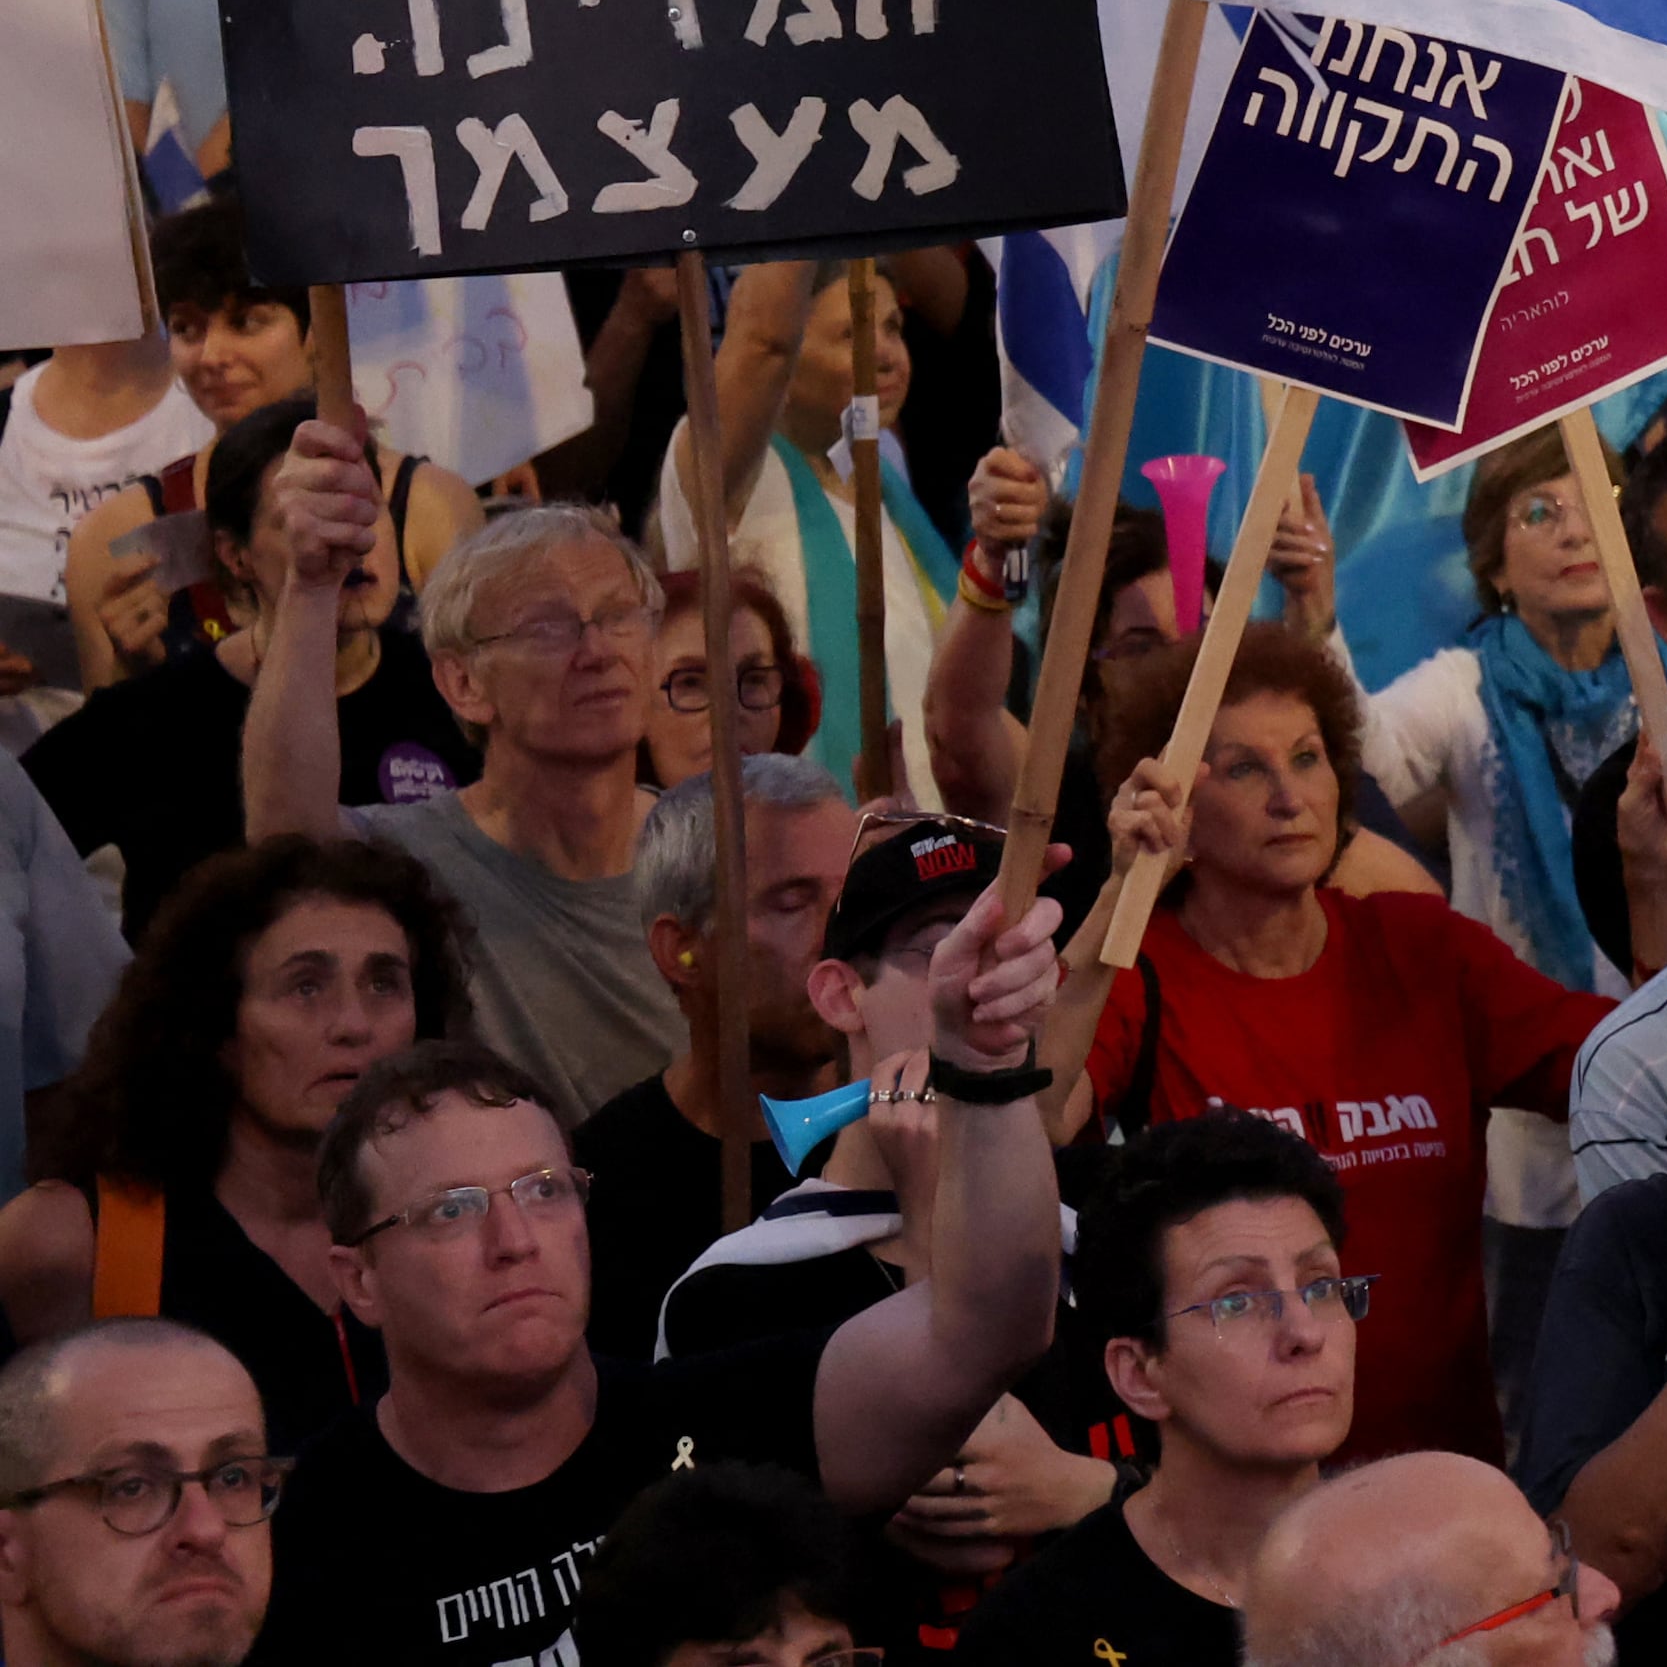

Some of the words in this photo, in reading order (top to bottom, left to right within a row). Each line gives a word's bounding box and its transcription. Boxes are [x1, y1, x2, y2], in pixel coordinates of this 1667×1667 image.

[1241, 65, 1514, 204] התקווה
[351, 94, 961, 257] מעצמך
[1563, 179, 1650, 251] של
[1266, 311, 1296, 336] הכל
[1298, 324, 1328, 345] לפני
[1328, 333, 1372, 358] ערכים
[1569, 334, 1610, 364] ערכים
[1508, 368, 1540, 391] הכל
[1539, 353, 1569, 377] לפני
[915, 842, 979, 883] NOW
[1336, 1094, 1439, 1144] מאבק
[435, 1567, 547, 1645] החיים
